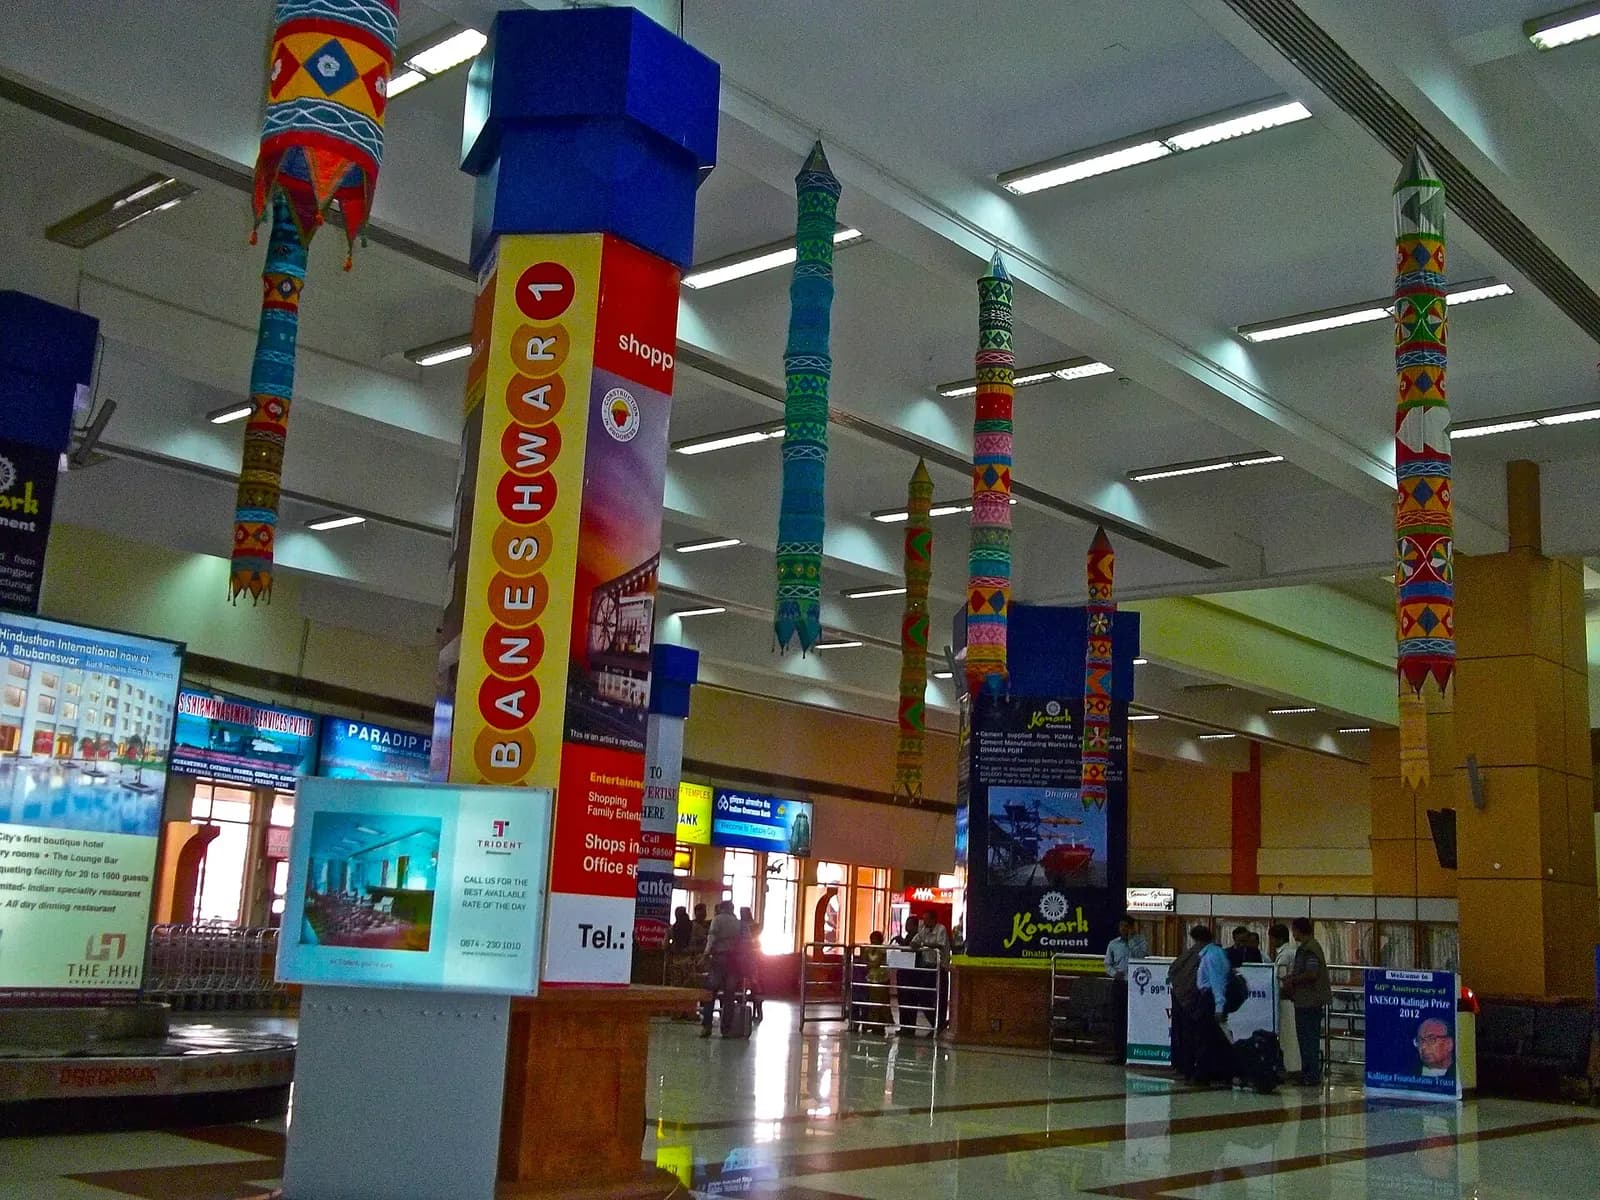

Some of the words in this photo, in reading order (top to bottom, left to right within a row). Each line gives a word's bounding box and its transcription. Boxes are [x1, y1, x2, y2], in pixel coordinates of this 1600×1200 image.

[527, 282, 564, 302] 1
[618, 333, 675, 372] shopp
[604, 389, 638, 417] CONSTRUCTION
[14, 554, 36, 566] from
[13, 646, 80, 665] Bhubaneswar
[58, 638, 119, 659] International
[120, 653, 139, 663] now
[254, 708, 288, 734] SERVICES
[1027, 708, 1072, 730] Konark
[348, 723, 418, 749] PARADIP
[570, 729, 584, 738] This
[599, 734, 619, 745] artist's
[1004, 740, 1047, 748] Manufacturing
[650, 766, 663, 779] TO
[588, 791, 628, 808] Shopping
[685, 788, 711, 799] TEMPLES
[587, 804, 615, 820] Family
[23, 834, 42, 843] first
[43, 838, 81, 848] boutique
[82, 839, 104, 849] hotel
[476, 839, 523, 849] TRIDENT
[584, 833, 626, 855] Shops
[642, 834, 660, 844] Call
[12, 851, 40, 859] rooms
[53, 852, 68, 860] The
[70, 854, 102, 864] Lounge
[104, 856, 119, 864] Bar
[583, 855, 624, 874] Office
[34, 867, 62, 878] facility
[64, 869, 76, 877] for
[79, 869, 89, 878] 20
[90, 871, 100, 879] to
[122, 874, 149, 882] guests
[463, 876, 482, 884] CALL
[484, 876, 496, 885] US
[496, 877, 512, 886] FOR
[513, 878, 529, 886] THE
[28, 883, 55, 892] Indian
[57, 886, 97, 896] speciality
[99, 888, 142, 897] restaurant
[464, 888, 483, 896] BEST
[484, 889, 526, 898] AVAILABLE
[5, 900, 17, 908] All
[20, 900, 37, 911] day
[73, 904, 117, 913] restaurant
[462, 900, 482, 909] RATE
[482, 901, 492, 909] OF
[494, 902, 510, 910] THE
[511, 903, 526, 911] DAY
[1003, 906, 1089, 949] Konark
[578, 922, 626, 950] Tel.:
[1039, 936, 1089, 947] Cement
[459, 938, 480, 948] 0874
[486, 940, 501, 949] 230
[502, 940, 521, 950] 1010
[67, 963, 101, 977] THE
[108, 964, 139, 978] HHI
[1150, 984, 1165, 994] 99th
[1391, 984, 1436, 994] Anniversary
[1437, 987, 1446, 995] of
[1369, 995, 1399, 1006] UNESCO
[1400, 997, 1429, 1009] Kalinga
[1431, 998, 1450, 1009] Prize
[1399, 1008, 1420, 1019] 2012
[1133, 1048, 1160, 1058] Hosted
[1160, 1049, 1171, 1059] by
[1367, 1071, 1393, 1081] Kalinga
[1393, 1072, 1434, 1085] Foundation
[1434, 1077, 1454, 1087] Trust
